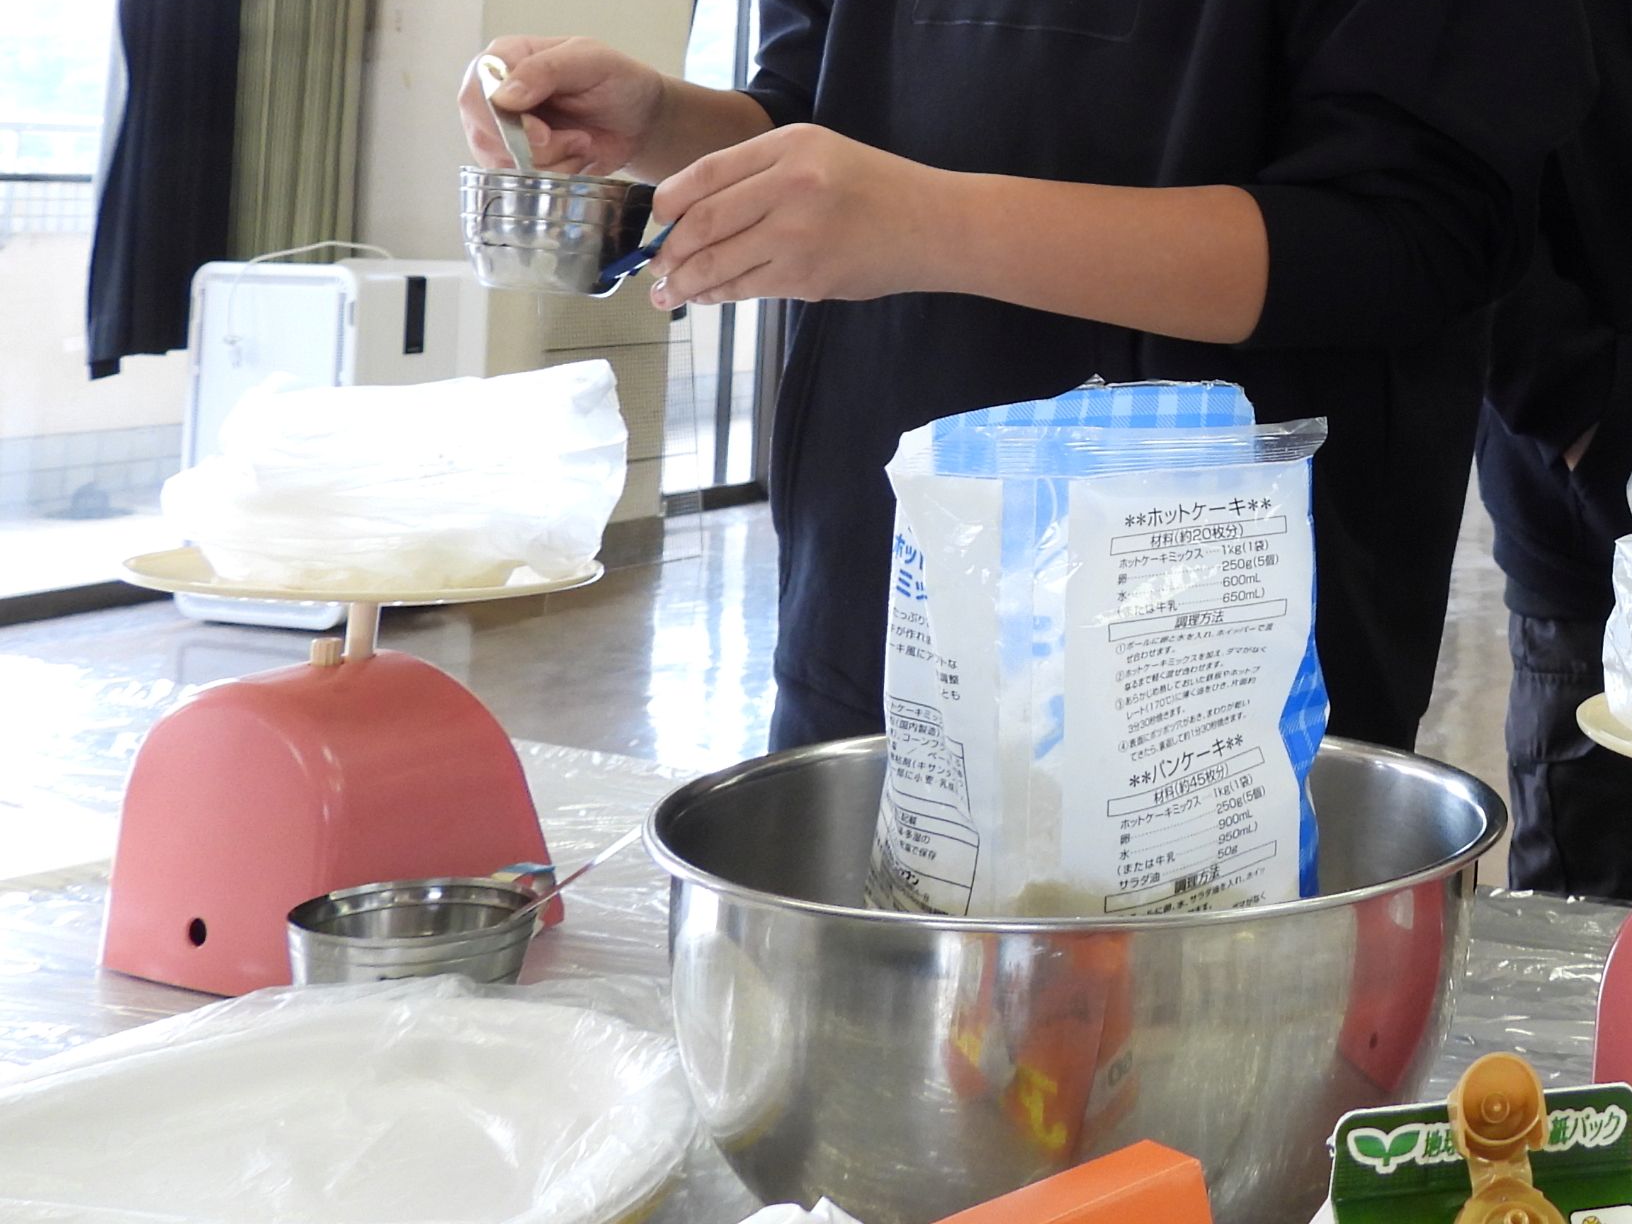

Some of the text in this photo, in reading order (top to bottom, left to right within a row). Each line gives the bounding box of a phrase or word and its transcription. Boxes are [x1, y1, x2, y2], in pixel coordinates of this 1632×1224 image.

[1118, 548, 1205, 570] ホットケーキミックス
[1222, 573, 1262, 588] 600mL
[1120, 795, 1202, 830] ホットケーキミックス
[1119, 809, 1254, 861] 水 900mL
